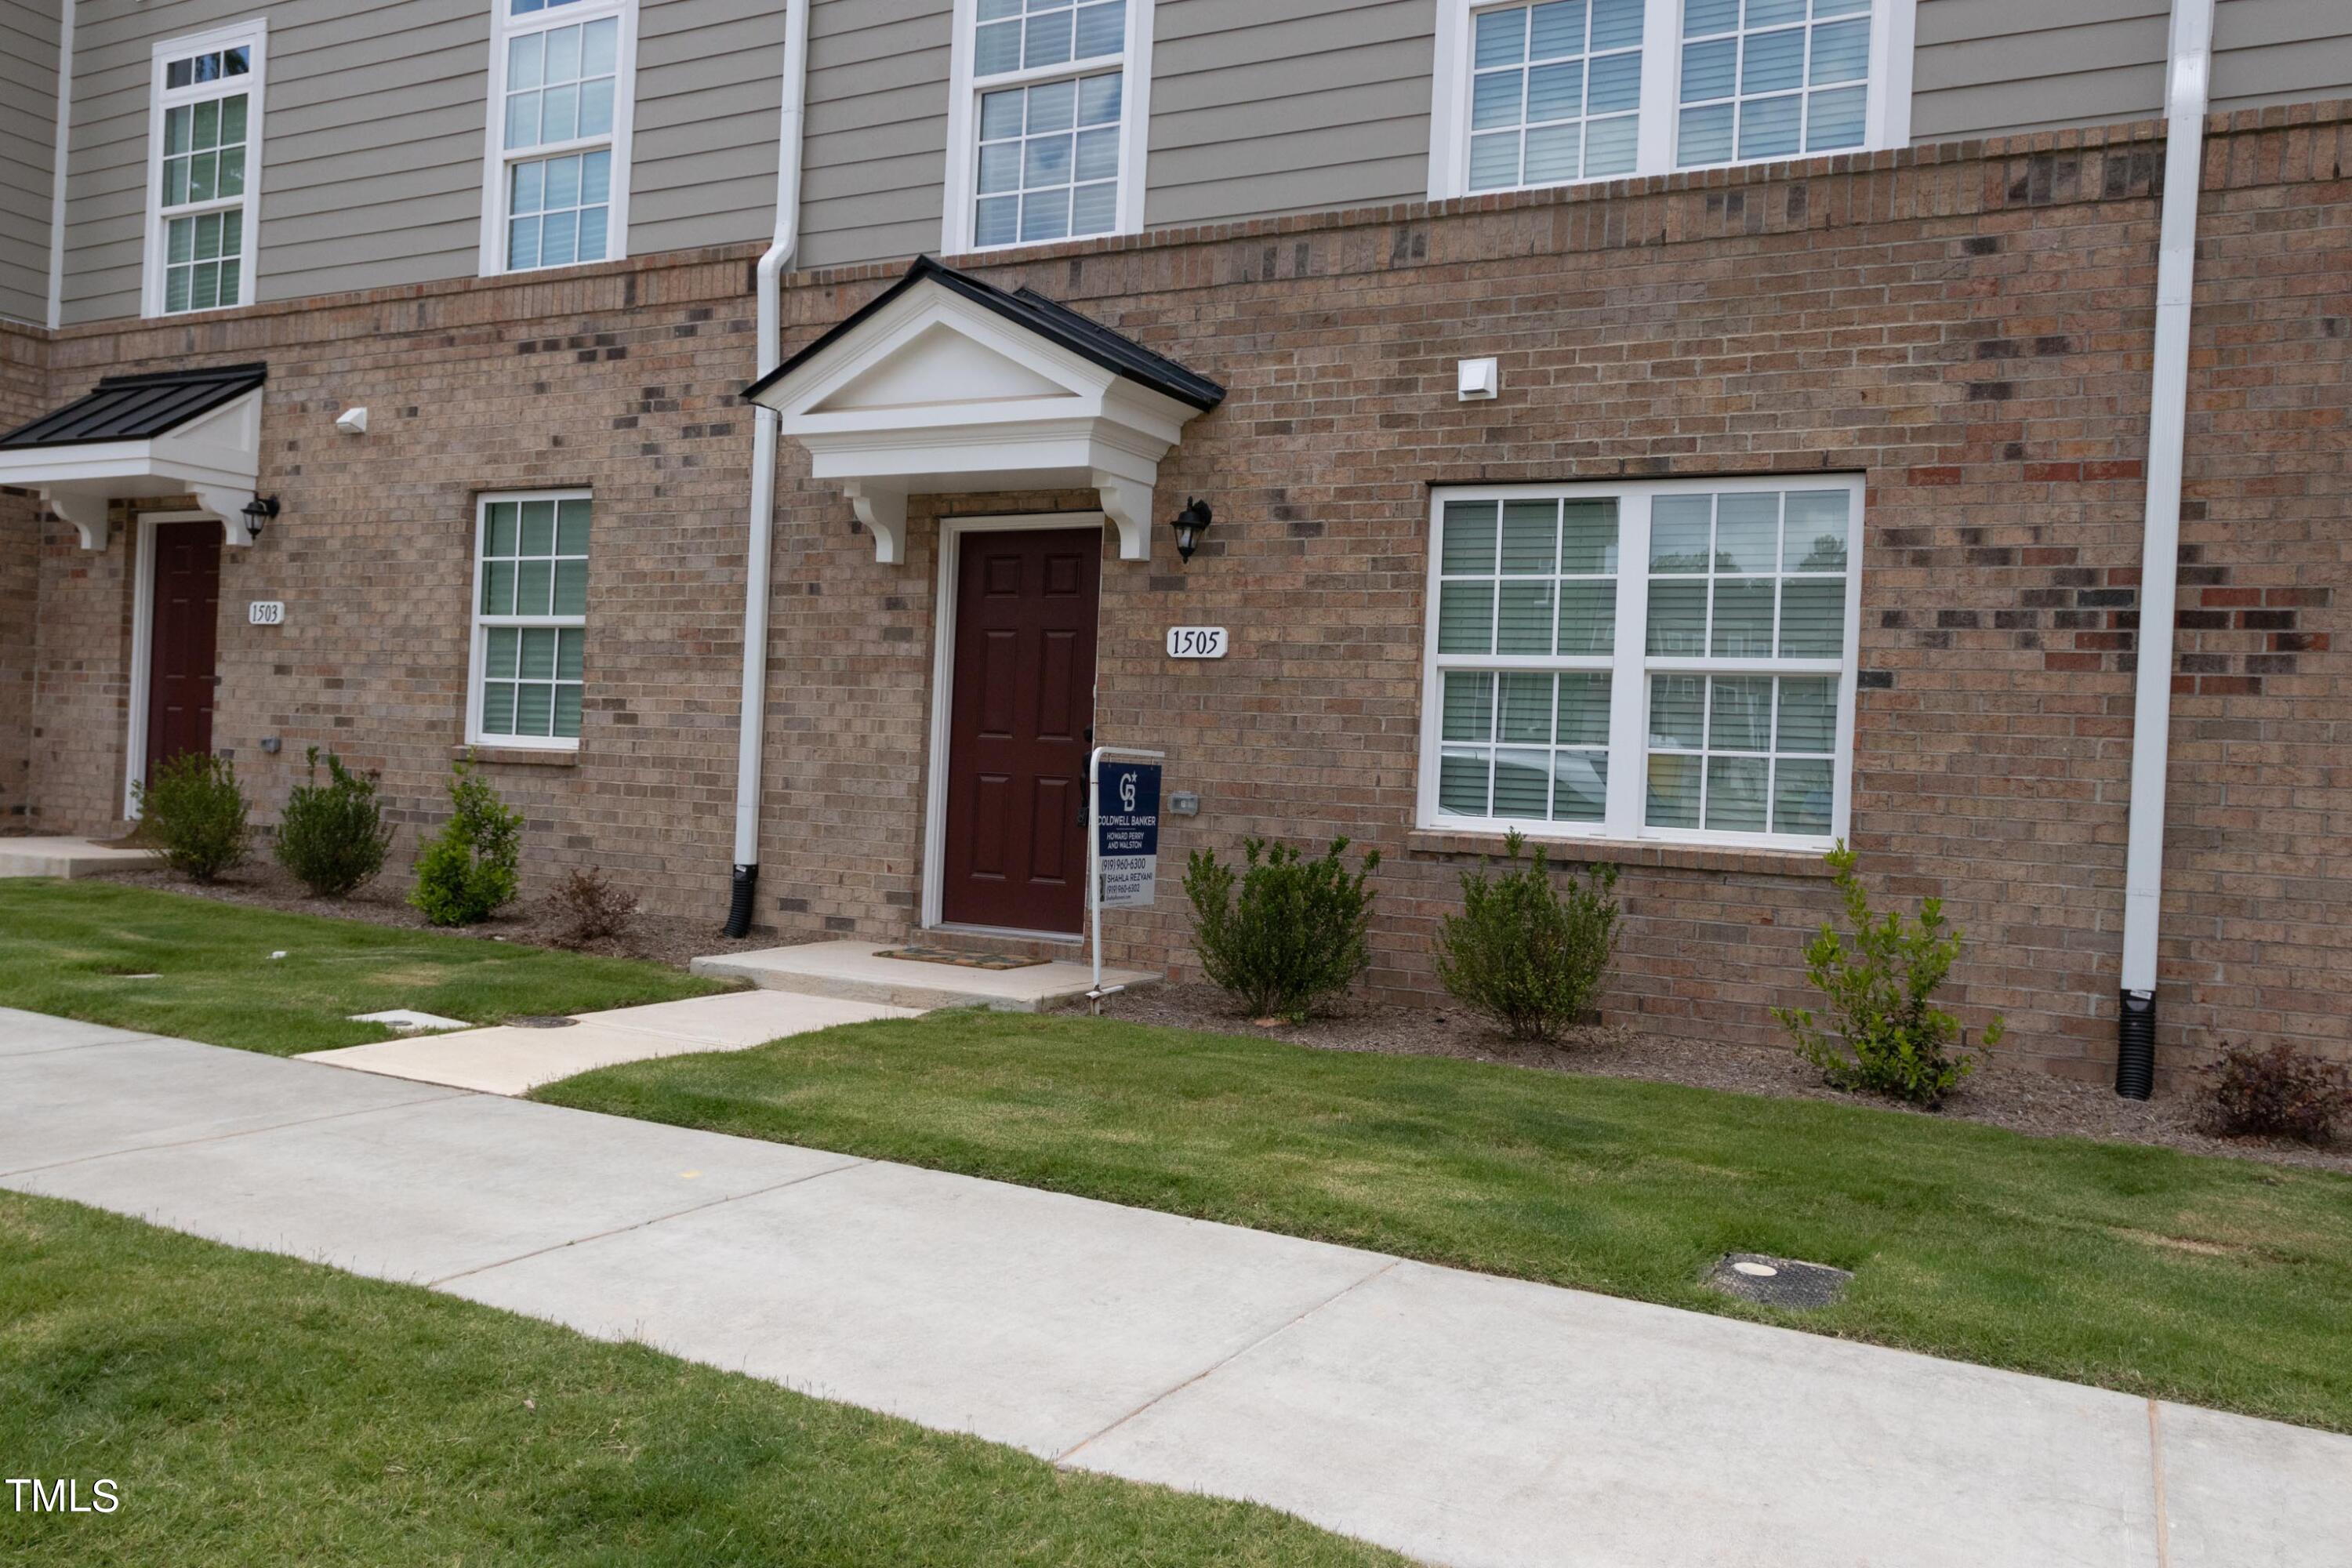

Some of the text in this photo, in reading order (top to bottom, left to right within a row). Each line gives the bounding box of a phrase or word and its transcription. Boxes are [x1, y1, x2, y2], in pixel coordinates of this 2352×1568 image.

[252, 604, 278, 622] 1503
[1174, 630, 1220, 655] 1505
[1098, 815, 1156, 826] COLDWELL BANKER
[1106, 831, 1145, 840] HOWARD PERRY
[1107, 840, 1142, 850] AND WALSTON
[1102, 858, 1146, 873] (919) 960-6300
[1107, 872, 1153, 884] SHAHLA REZVANI
[1106, 885, 1118, 895] (919)
